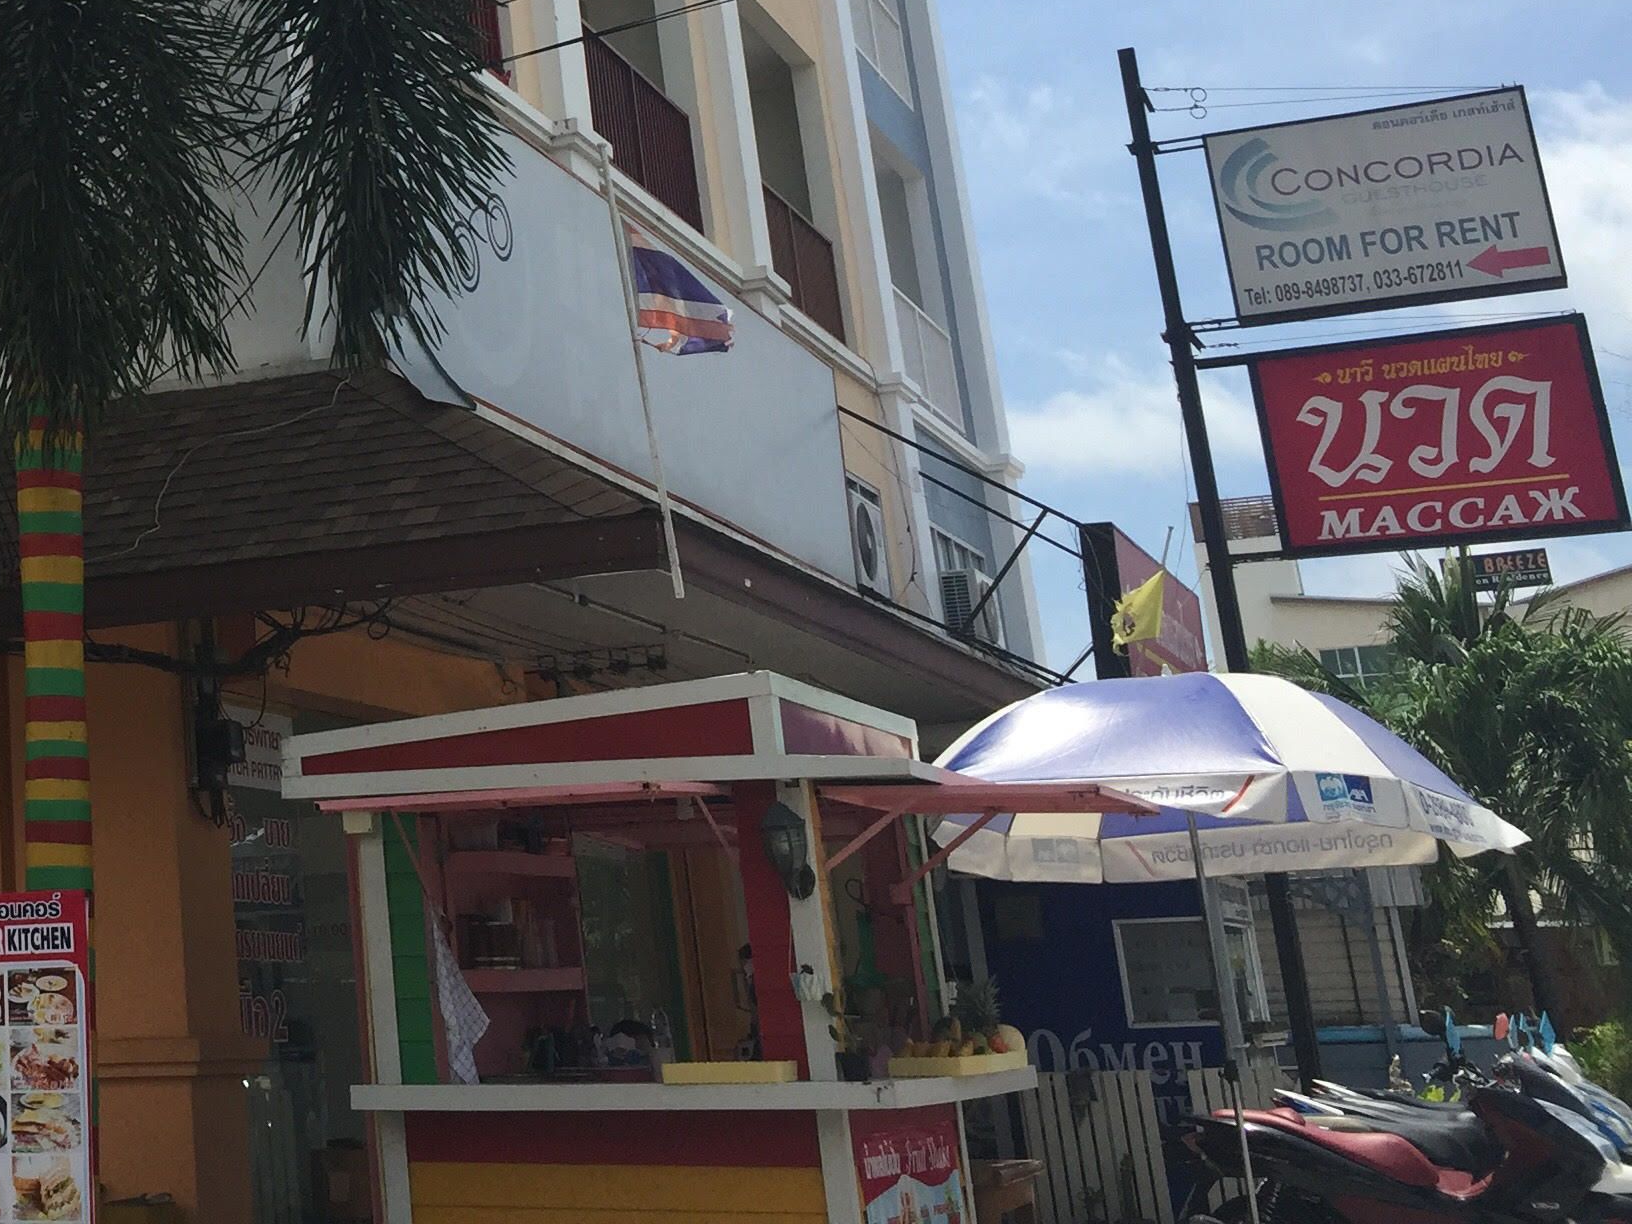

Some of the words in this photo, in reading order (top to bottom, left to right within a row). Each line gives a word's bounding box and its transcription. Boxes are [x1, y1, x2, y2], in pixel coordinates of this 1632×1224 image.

[1271, 142, 1525, 196] CONCORDIA
[1341, 174, 1488, 205] GUESTHOUSE
[1255, 234, 1352, 271] ROOM
[1361, 225, 1429, 257] FOR
[1436, 211, 1520, 248] RENT
[1244, 287, 1272, 306] Tel:
[1275, 272, 1370, 303] 089-8498737,
[1373, 260, 1465, 290] 033-672811
[1381, 344, 1503, 379] นวดแผนไทย
[1296, 375, 1556, 488] นวด
[1317, 486, 1586, 540] МАССАЖ
[1483, 552, 1547, 573] BREEZE
[251, 761, 283, 781] PATTA
[7, 926, 72, 952] KITCHEN
